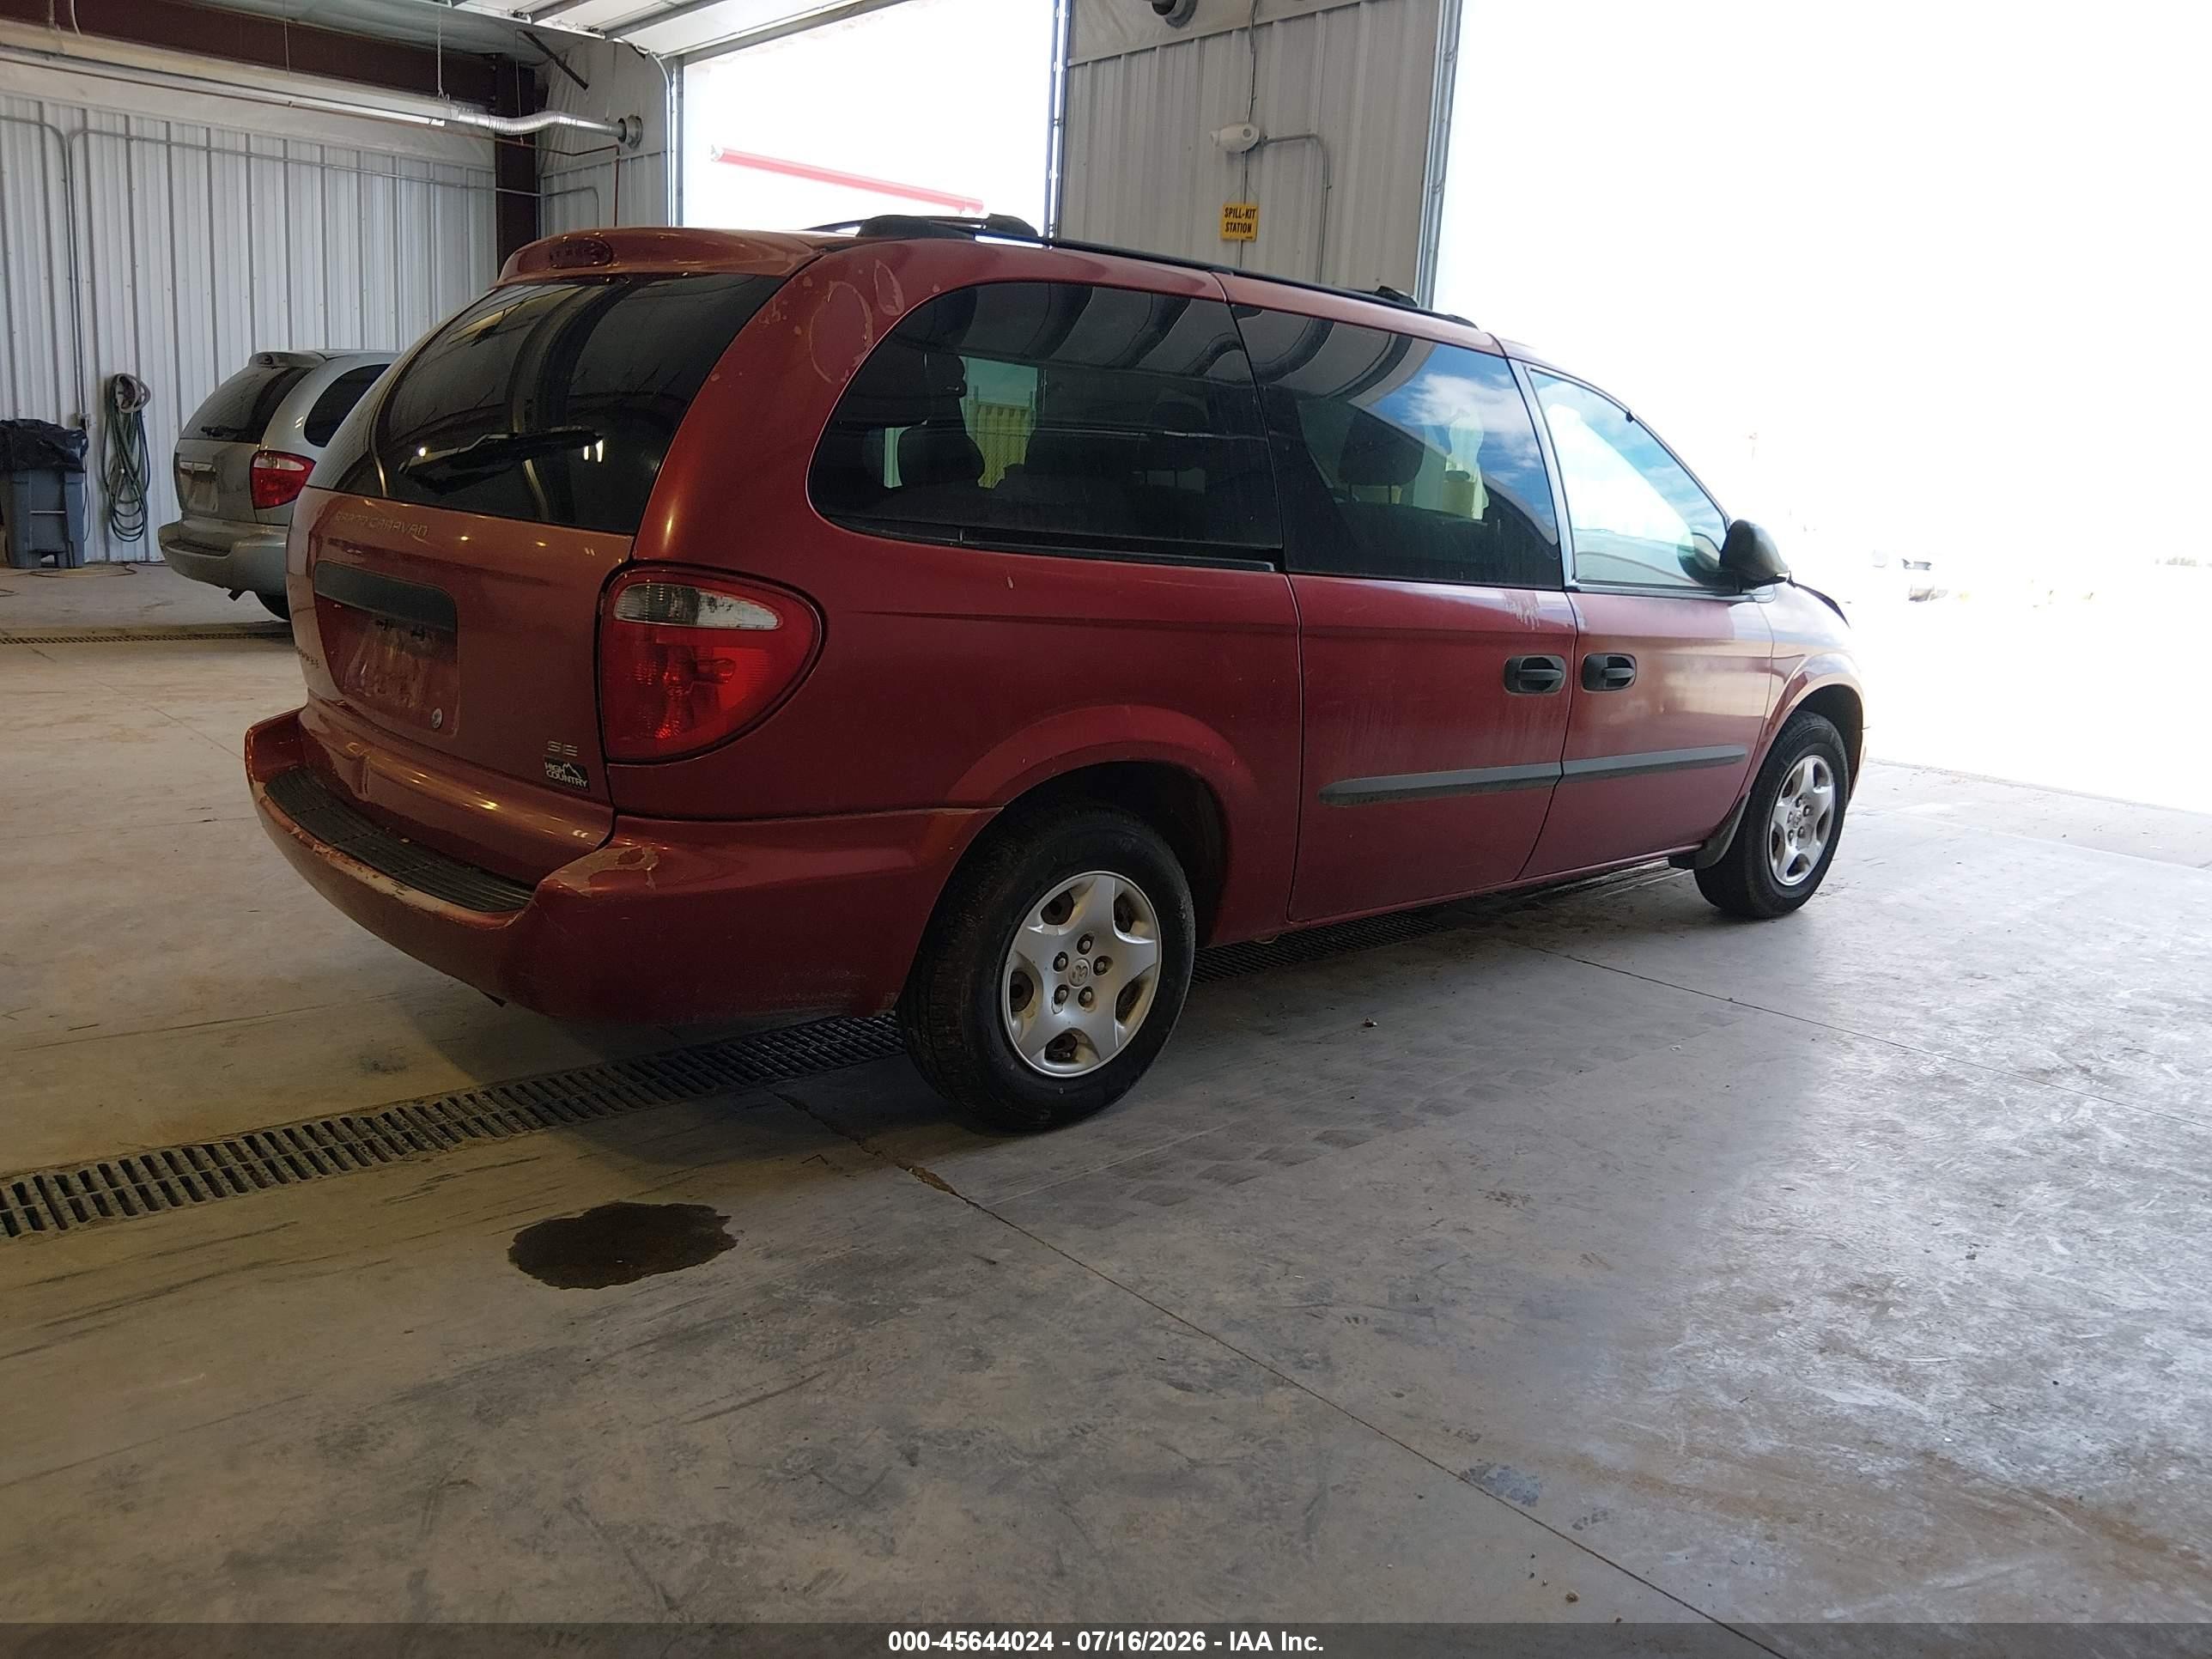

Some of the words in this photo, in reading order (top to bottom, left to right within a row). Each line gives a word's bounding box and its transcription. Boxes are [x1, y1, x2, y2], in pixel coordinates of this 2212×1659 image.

[1224, 207, 1256, 220] SPILL-KIT
[1224, 222, 1252, 234] STATION
[544, 762, 565, 774] HIGH
[546, 769, 588, 787] COUNTRY
